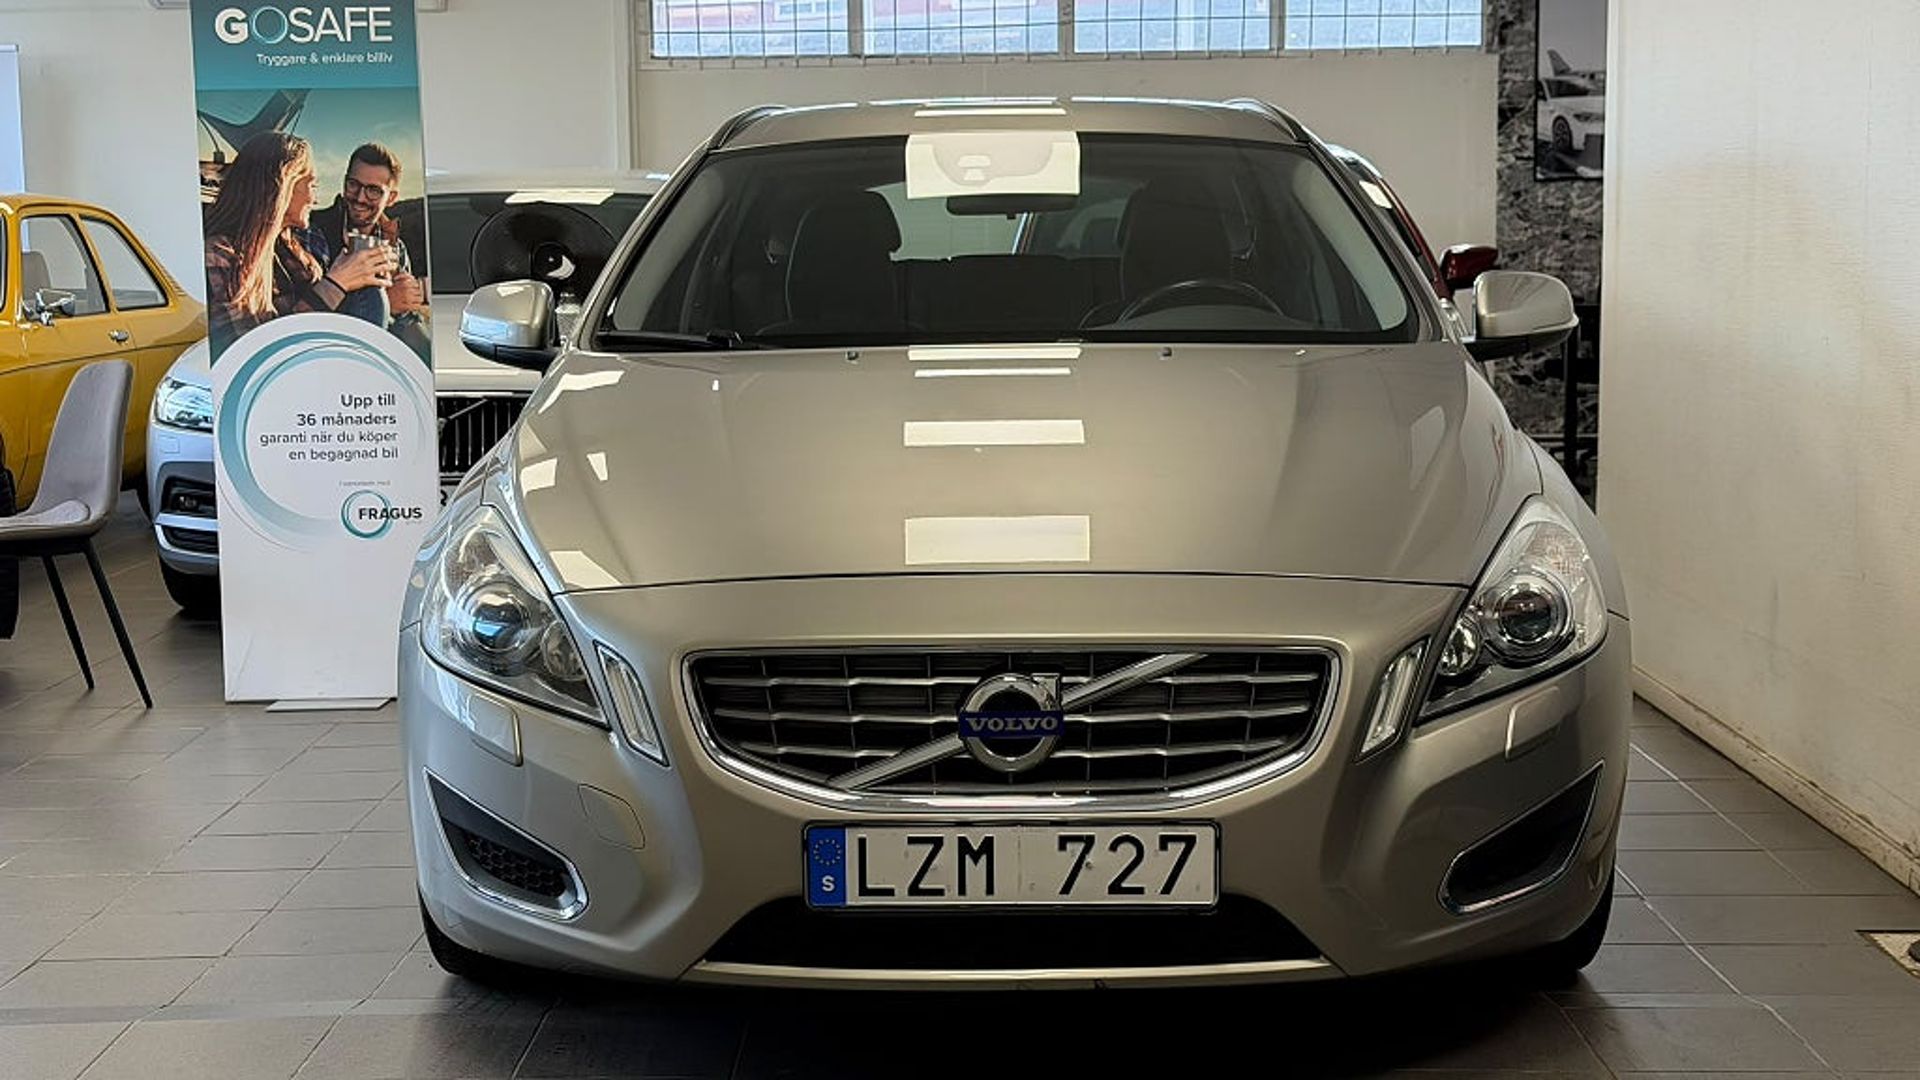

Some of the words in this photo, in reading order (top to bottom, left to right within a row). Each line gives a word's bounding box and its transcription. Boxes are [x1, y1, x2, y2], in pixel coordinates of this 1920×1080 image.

[215, 6, 393, 44] GOSAFE
[257, 53, 307, 66] Tryggare
[310, 52, 318, 63] &
[322, 53, 364, 63] enklare
[341, 394, 373, 409] Upp
[378, 393, 396, 406] till
[297, 413, 317, 426] 36
[321, 411, 397, 426] månaders
[260, 431, 307, 447] garanti
[311, 432, 333, 443] när
[337, 430, 355, 443] du
[359, 431, 398, 444] köper
[288, 452, 306, 460] en
[310, 447, 378, 461] begagnad
[382, 447, 398, 459] bil
[358, 507, 422, 520] FRAGUS
[964, 716, 1059, 732] VOLVO
[857, 834, 995, 897] LZM
[1057, 833, 1197, 896] 727
[821, 875, 835, 892] S
